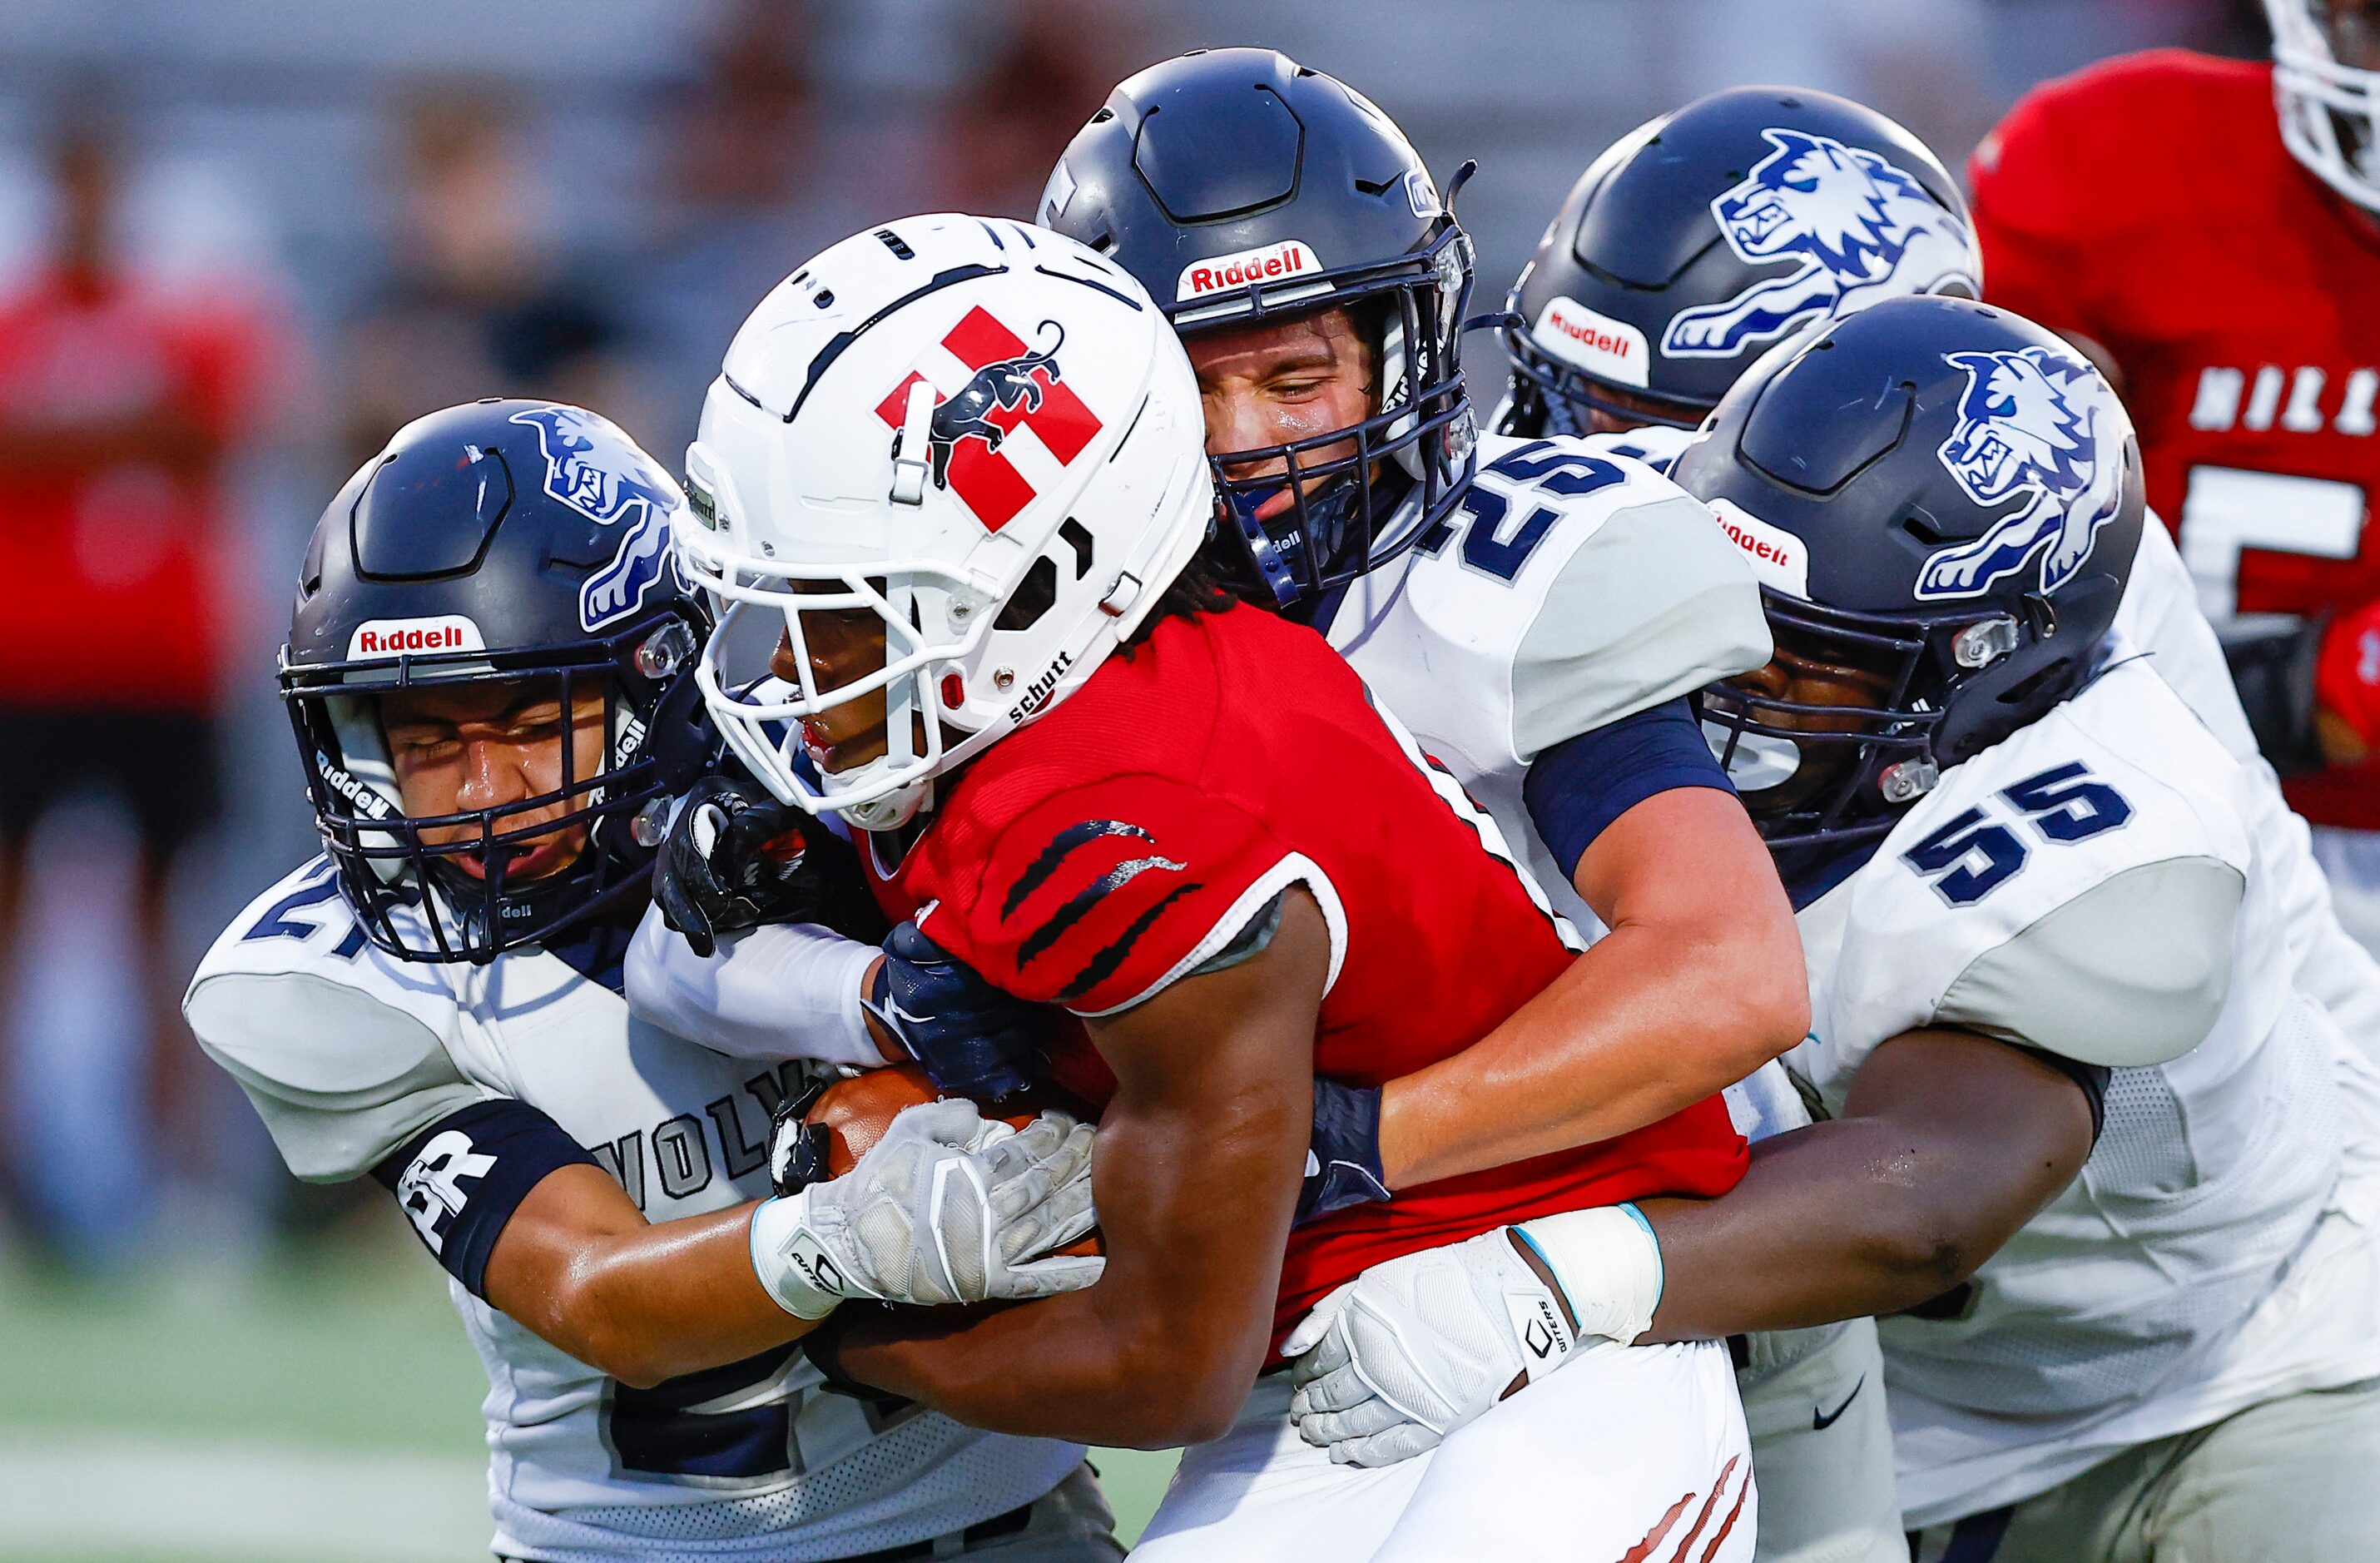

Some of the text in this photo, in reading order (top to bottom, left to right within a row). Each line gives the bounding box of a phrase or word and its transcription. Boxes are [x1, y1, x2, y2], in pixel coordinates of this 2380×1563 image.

[1191, 247, 1302, 292] Riddell
[1411, 440, 1632, 588] 25
[360, 626, 463, 652] Riddell
[1009, 650, 1075, 724] schutt
[1897, 758, 2138, 909] 55
[1538, 1300, 1568, 1354] CUTTERS
